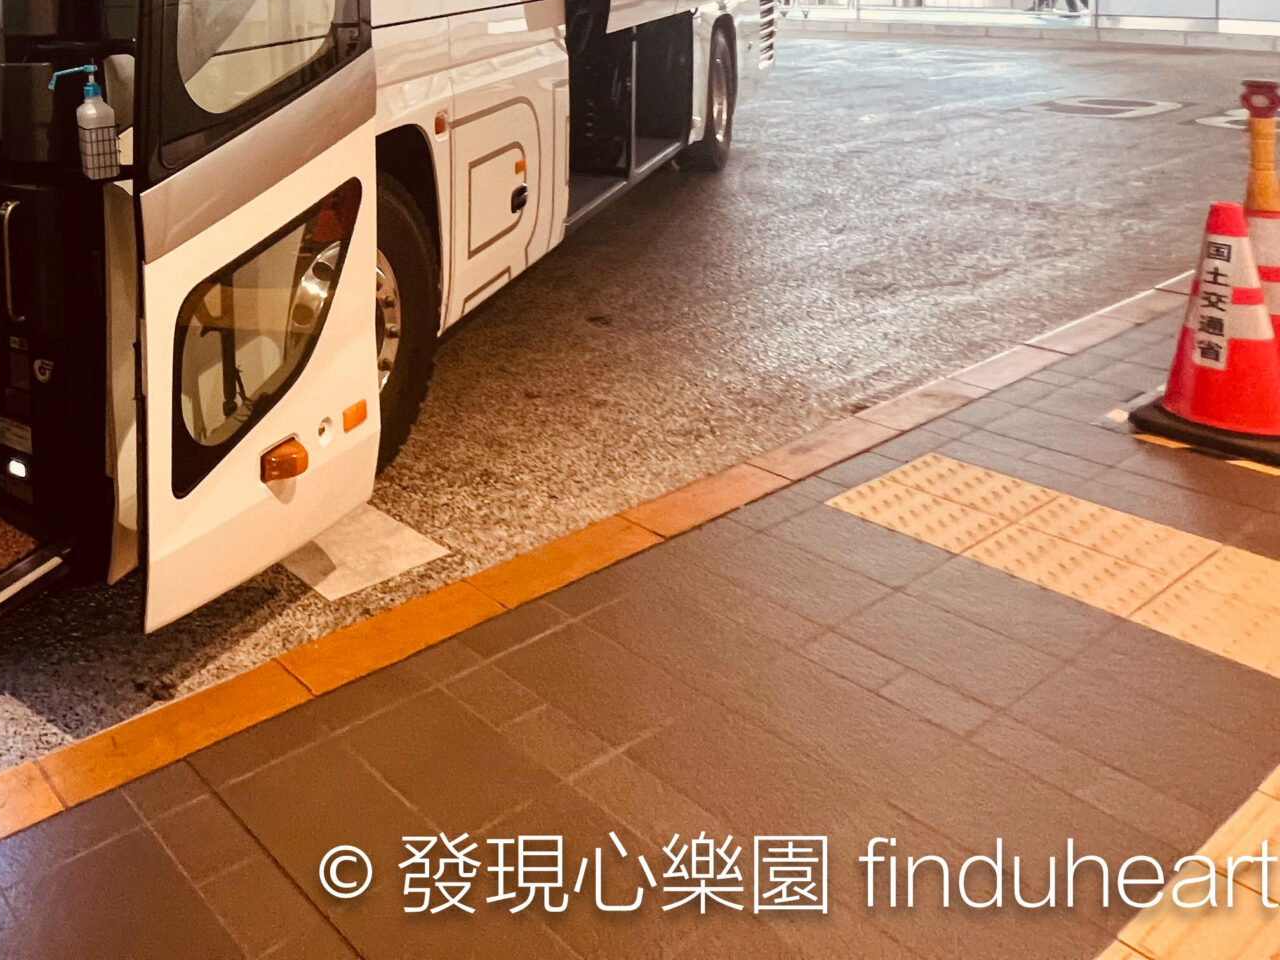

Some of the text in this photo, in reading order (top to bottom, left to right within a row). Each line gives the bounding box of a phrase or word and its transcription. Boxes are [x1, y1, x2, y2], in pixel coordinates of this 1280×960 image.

[1198, 240, 1232, 363] 国土交通省
